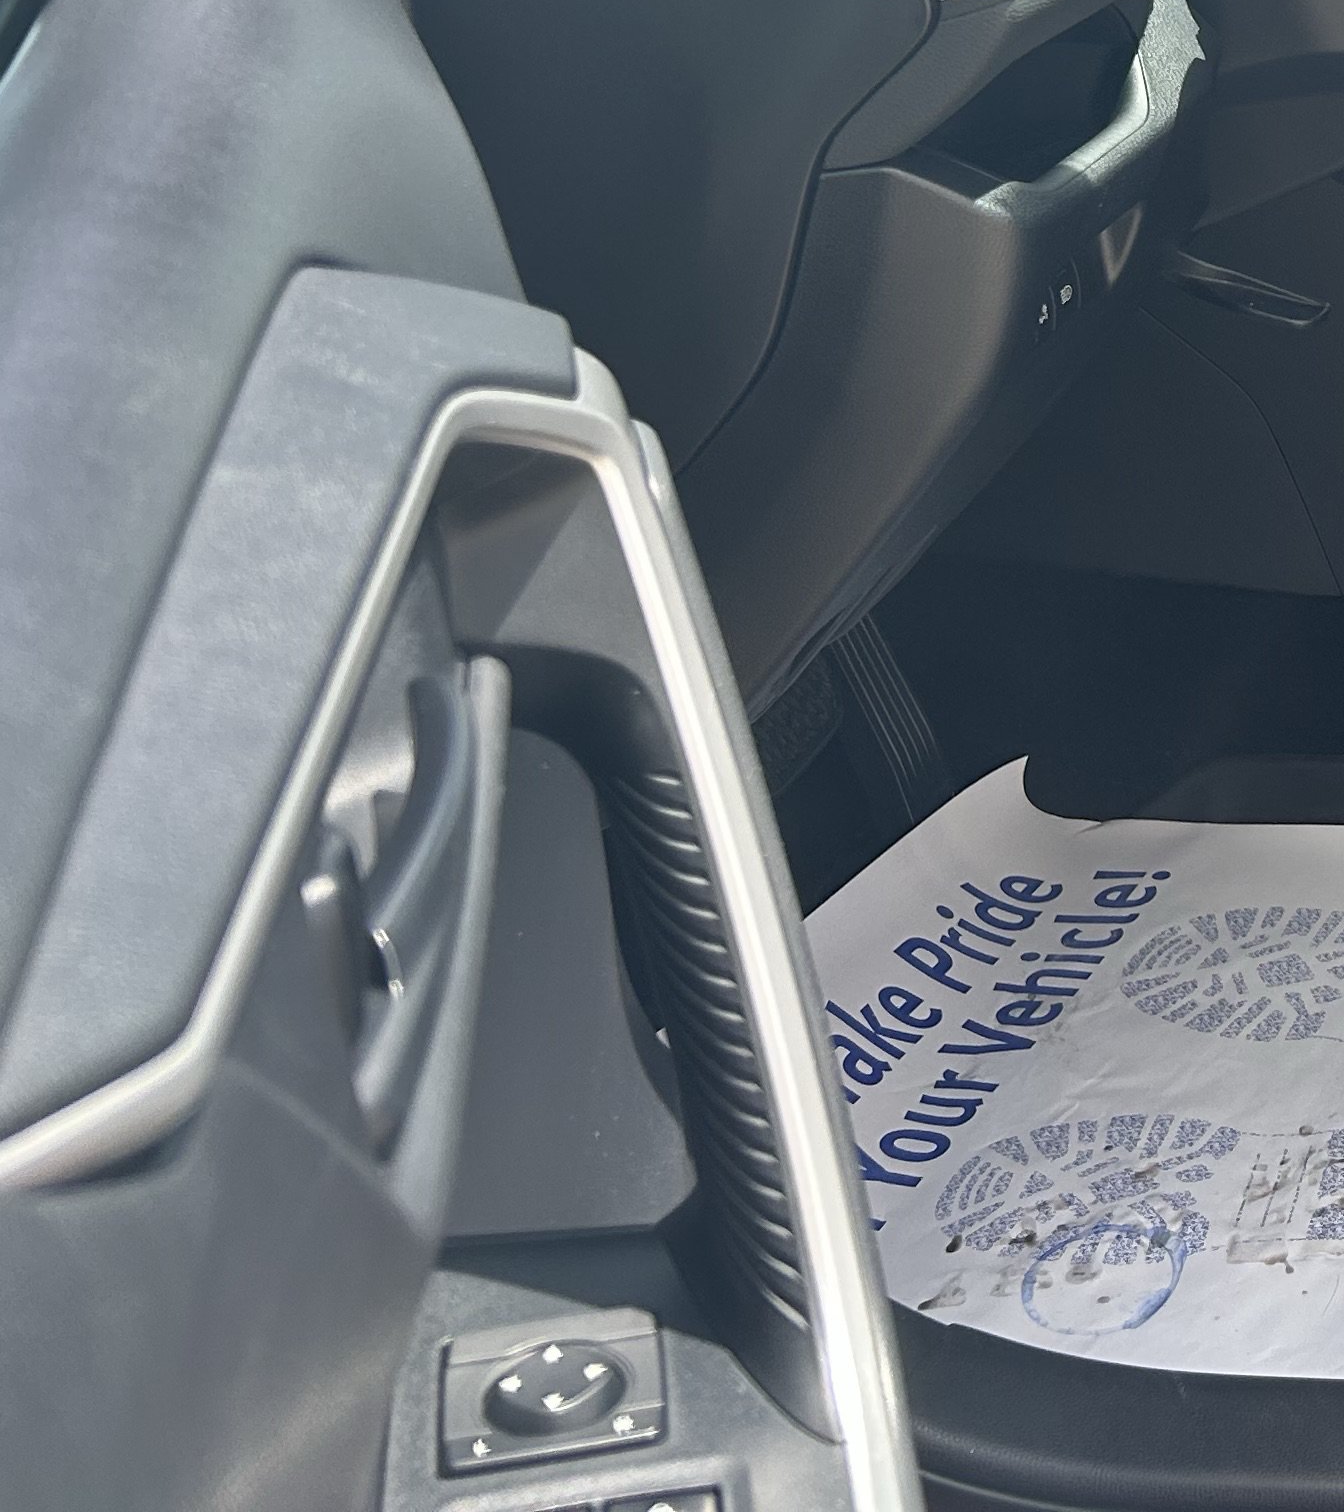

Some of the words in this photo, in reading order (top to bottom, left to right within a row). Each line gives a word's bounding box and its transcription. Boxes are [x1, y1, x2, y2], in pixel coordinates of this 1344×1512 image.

[825, 986, 942, 1104] ake
[894, 875, 1063, 994] Pride
[853, 1069, 999, 1188] Your
[938, 871, 1171, 1054] Vehicle!
